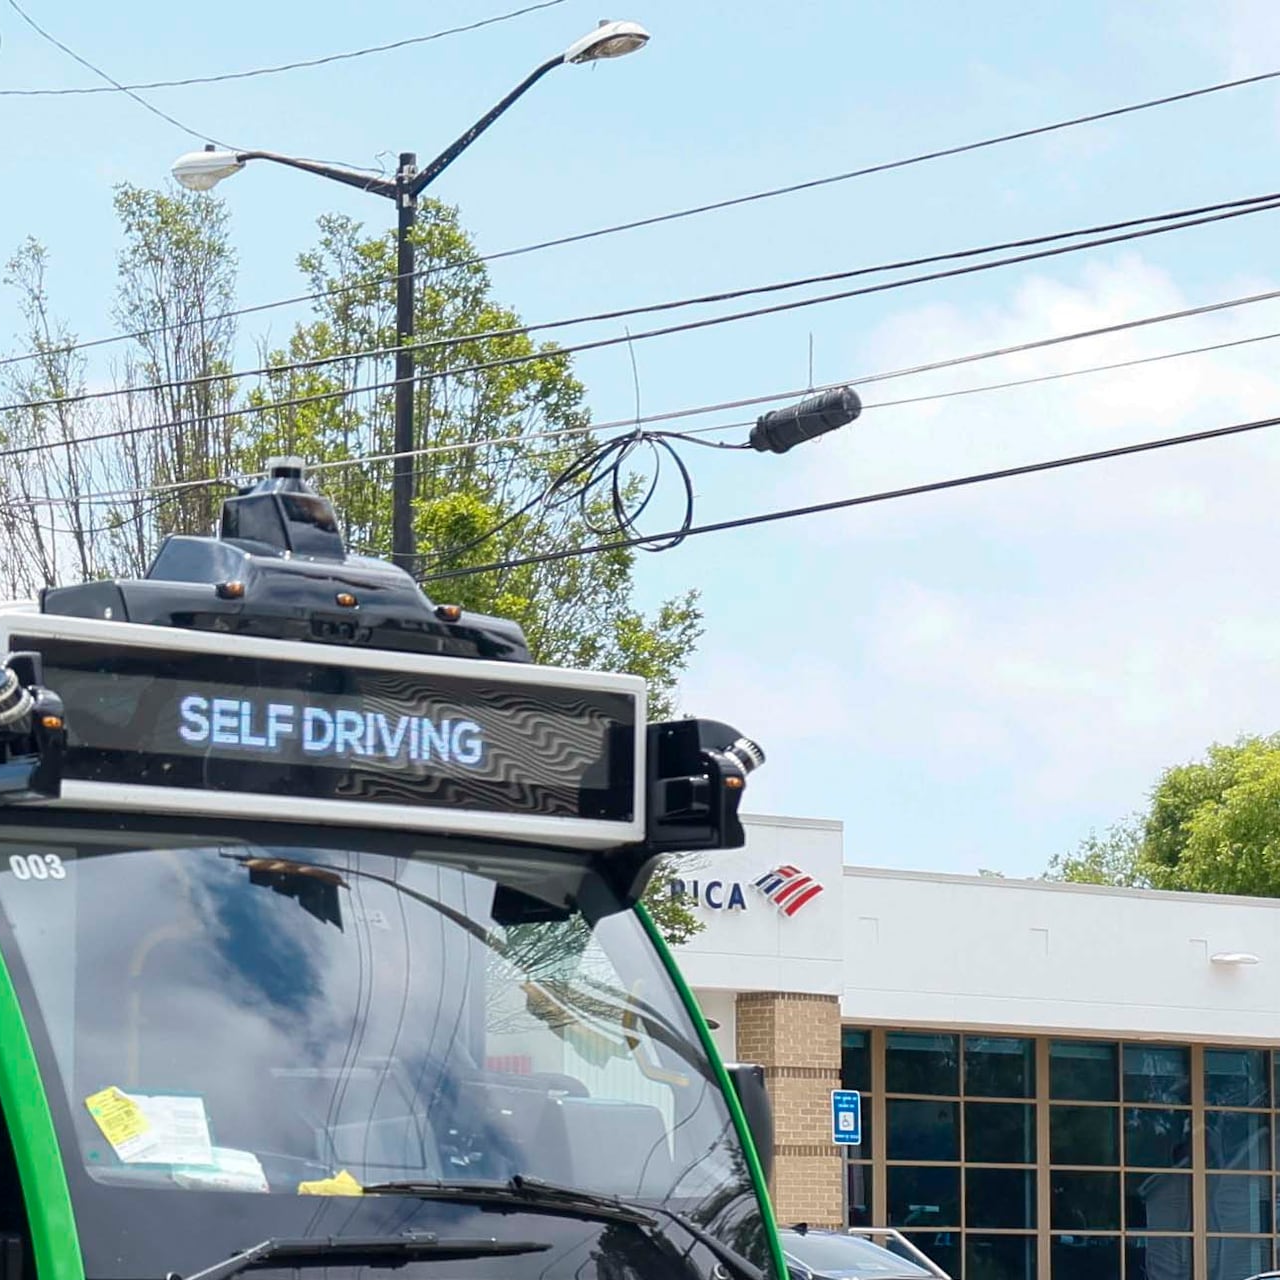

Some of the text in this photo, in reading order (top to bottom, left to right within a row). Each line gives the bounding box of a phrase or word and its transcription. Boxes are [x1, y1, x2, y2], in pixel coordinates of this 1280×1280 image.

[177, 695, 483, 764] SELF DRIVING
[8, 852, 67, 881] 003
